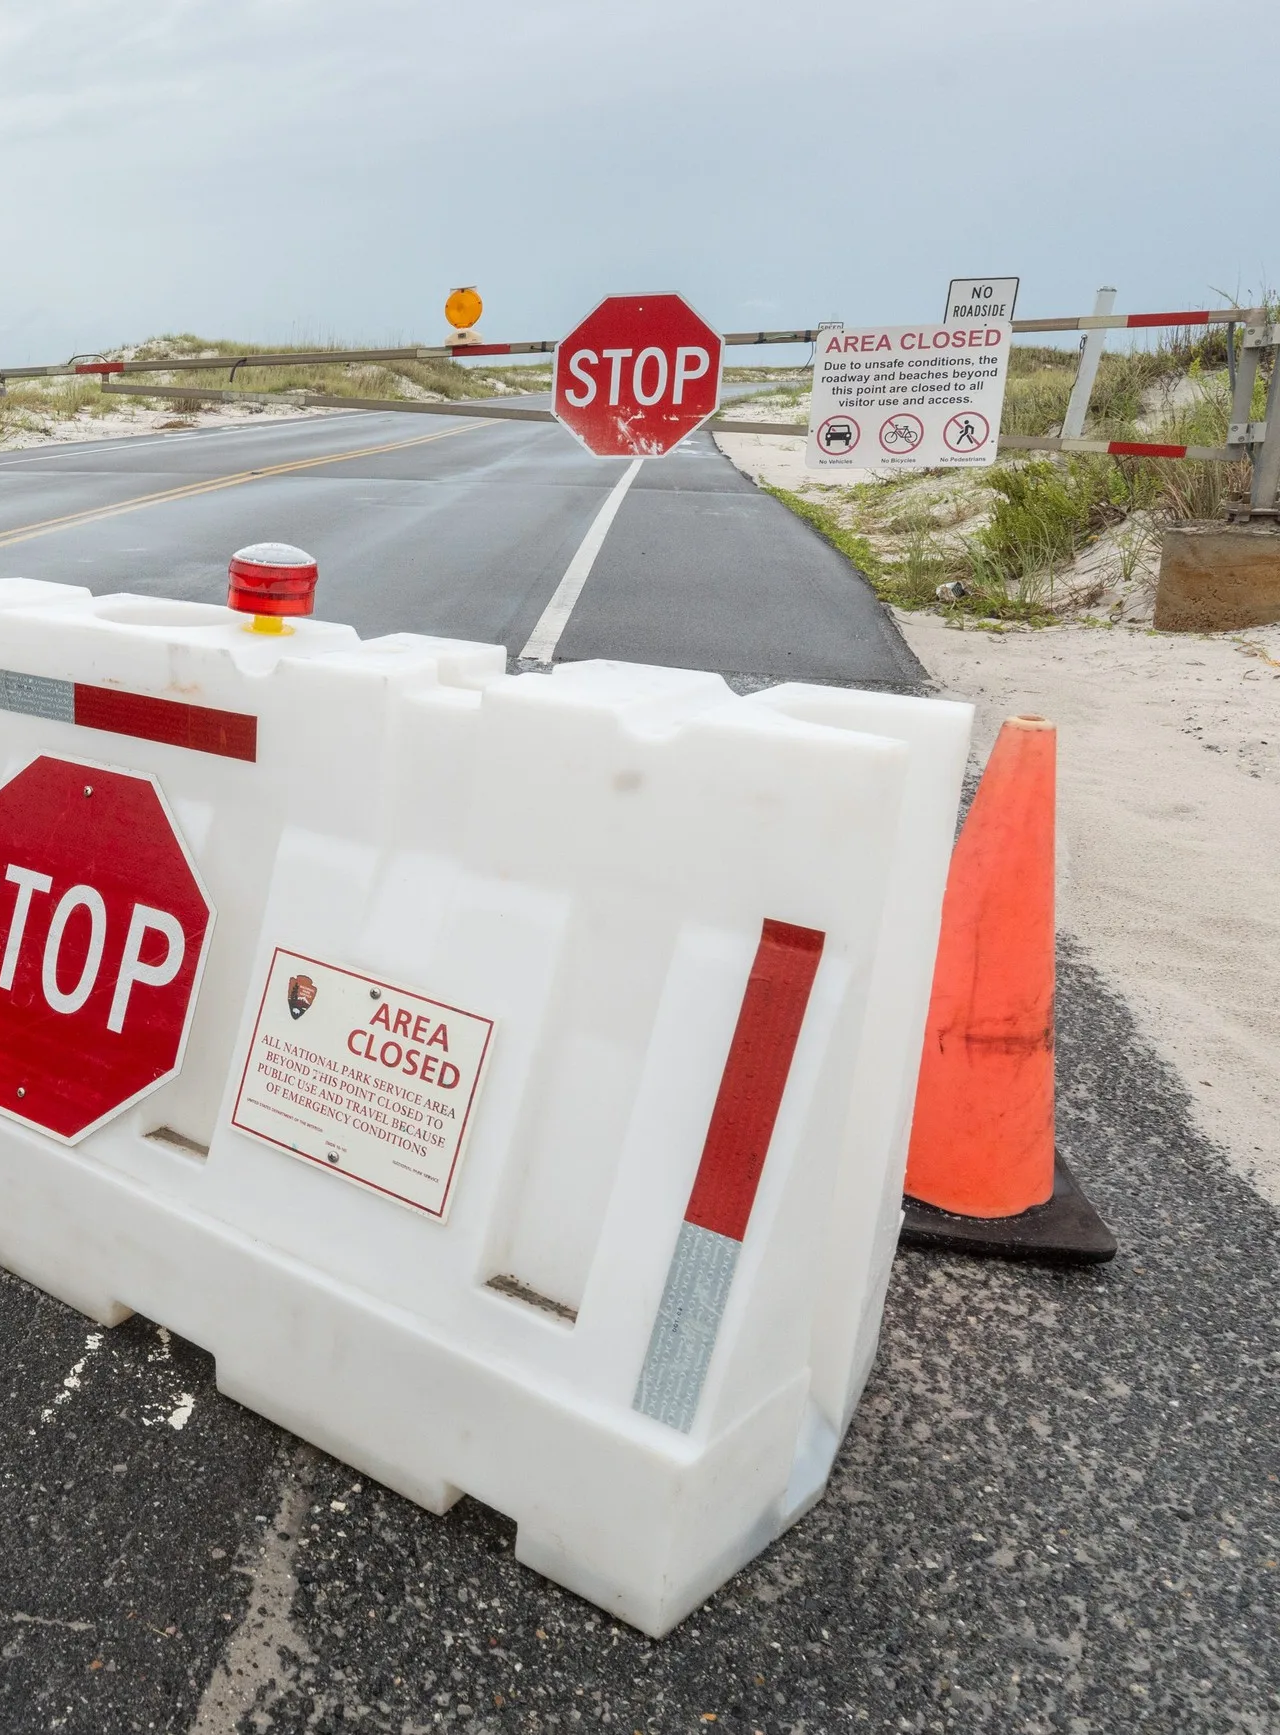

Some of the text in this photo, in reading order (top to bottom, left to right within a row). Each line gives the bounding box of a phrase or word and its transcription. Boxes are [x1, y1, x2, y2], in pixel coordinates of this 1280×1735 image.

[972, 287, 992, 299] NO
[953, 304, 1006, 318] ROADSIDE
[825, 329, 1002, 354] AREA CLOSED
[824, 355, 998, 371] Due to unsafe conditions, the
[565, 346, 710, 407] STOP
[821, 368, 998, 384] roadway and beaches beyond
[832, 381, 984, 396] this point are closed to all
[839, 396, 973, 407] visitor use and access.
[889, 457, 916, 465] Bicycles
[369, 1002, 449, 1052] AREA
[347, 1029, 461, 1090] CLOSED
[261, 1034, 456, 1120] ALL NATIONAL PARK SERVICE AREA
[266, 1051, 311, 1076] BEYOND
[340, 1080, 376, 1103] POINT
[377, 1096, 424, 1122] CLOSED
[426, 1114, 444, 1130] TO
[257, 1062, 446, 1149] PUBLIC USE AND TRAVEL BECAUSE
[266, 1082, 428, 1158] OF EMERGENCY CONDITIONS
